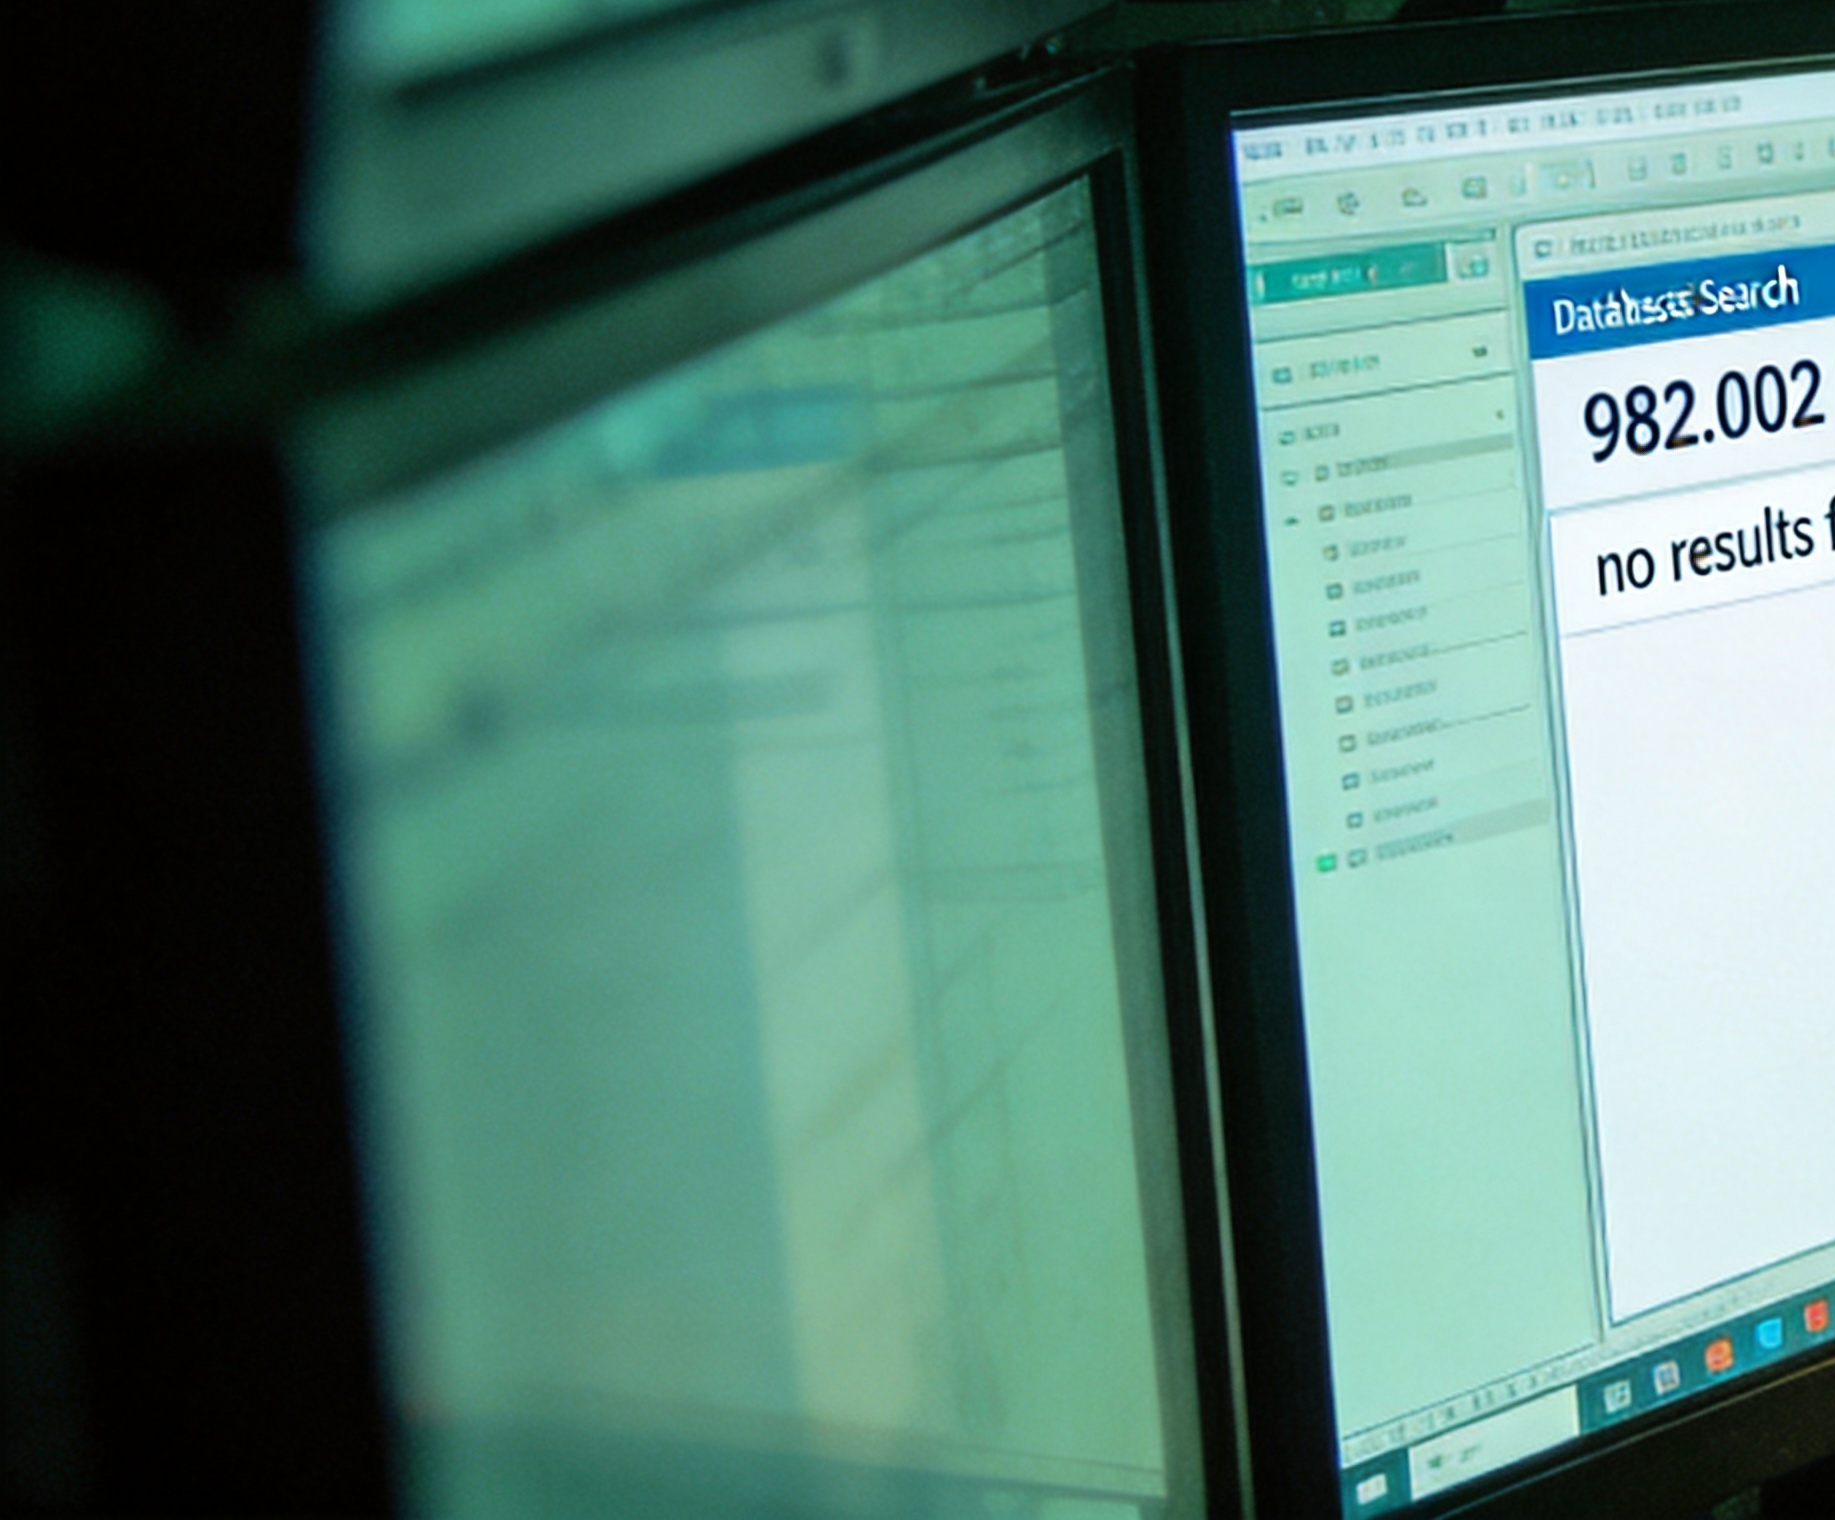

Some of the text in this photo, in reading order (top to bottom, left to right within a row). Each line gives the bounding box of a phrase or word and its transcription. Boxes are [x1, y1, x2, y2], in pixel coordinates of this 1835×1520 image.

[1698, 263, 1800, 316] Search
[1583, 358, 1827, 465] 982.002
[1596, 545, 1656, 598] no
[1670, 505, 1815, 583] results
